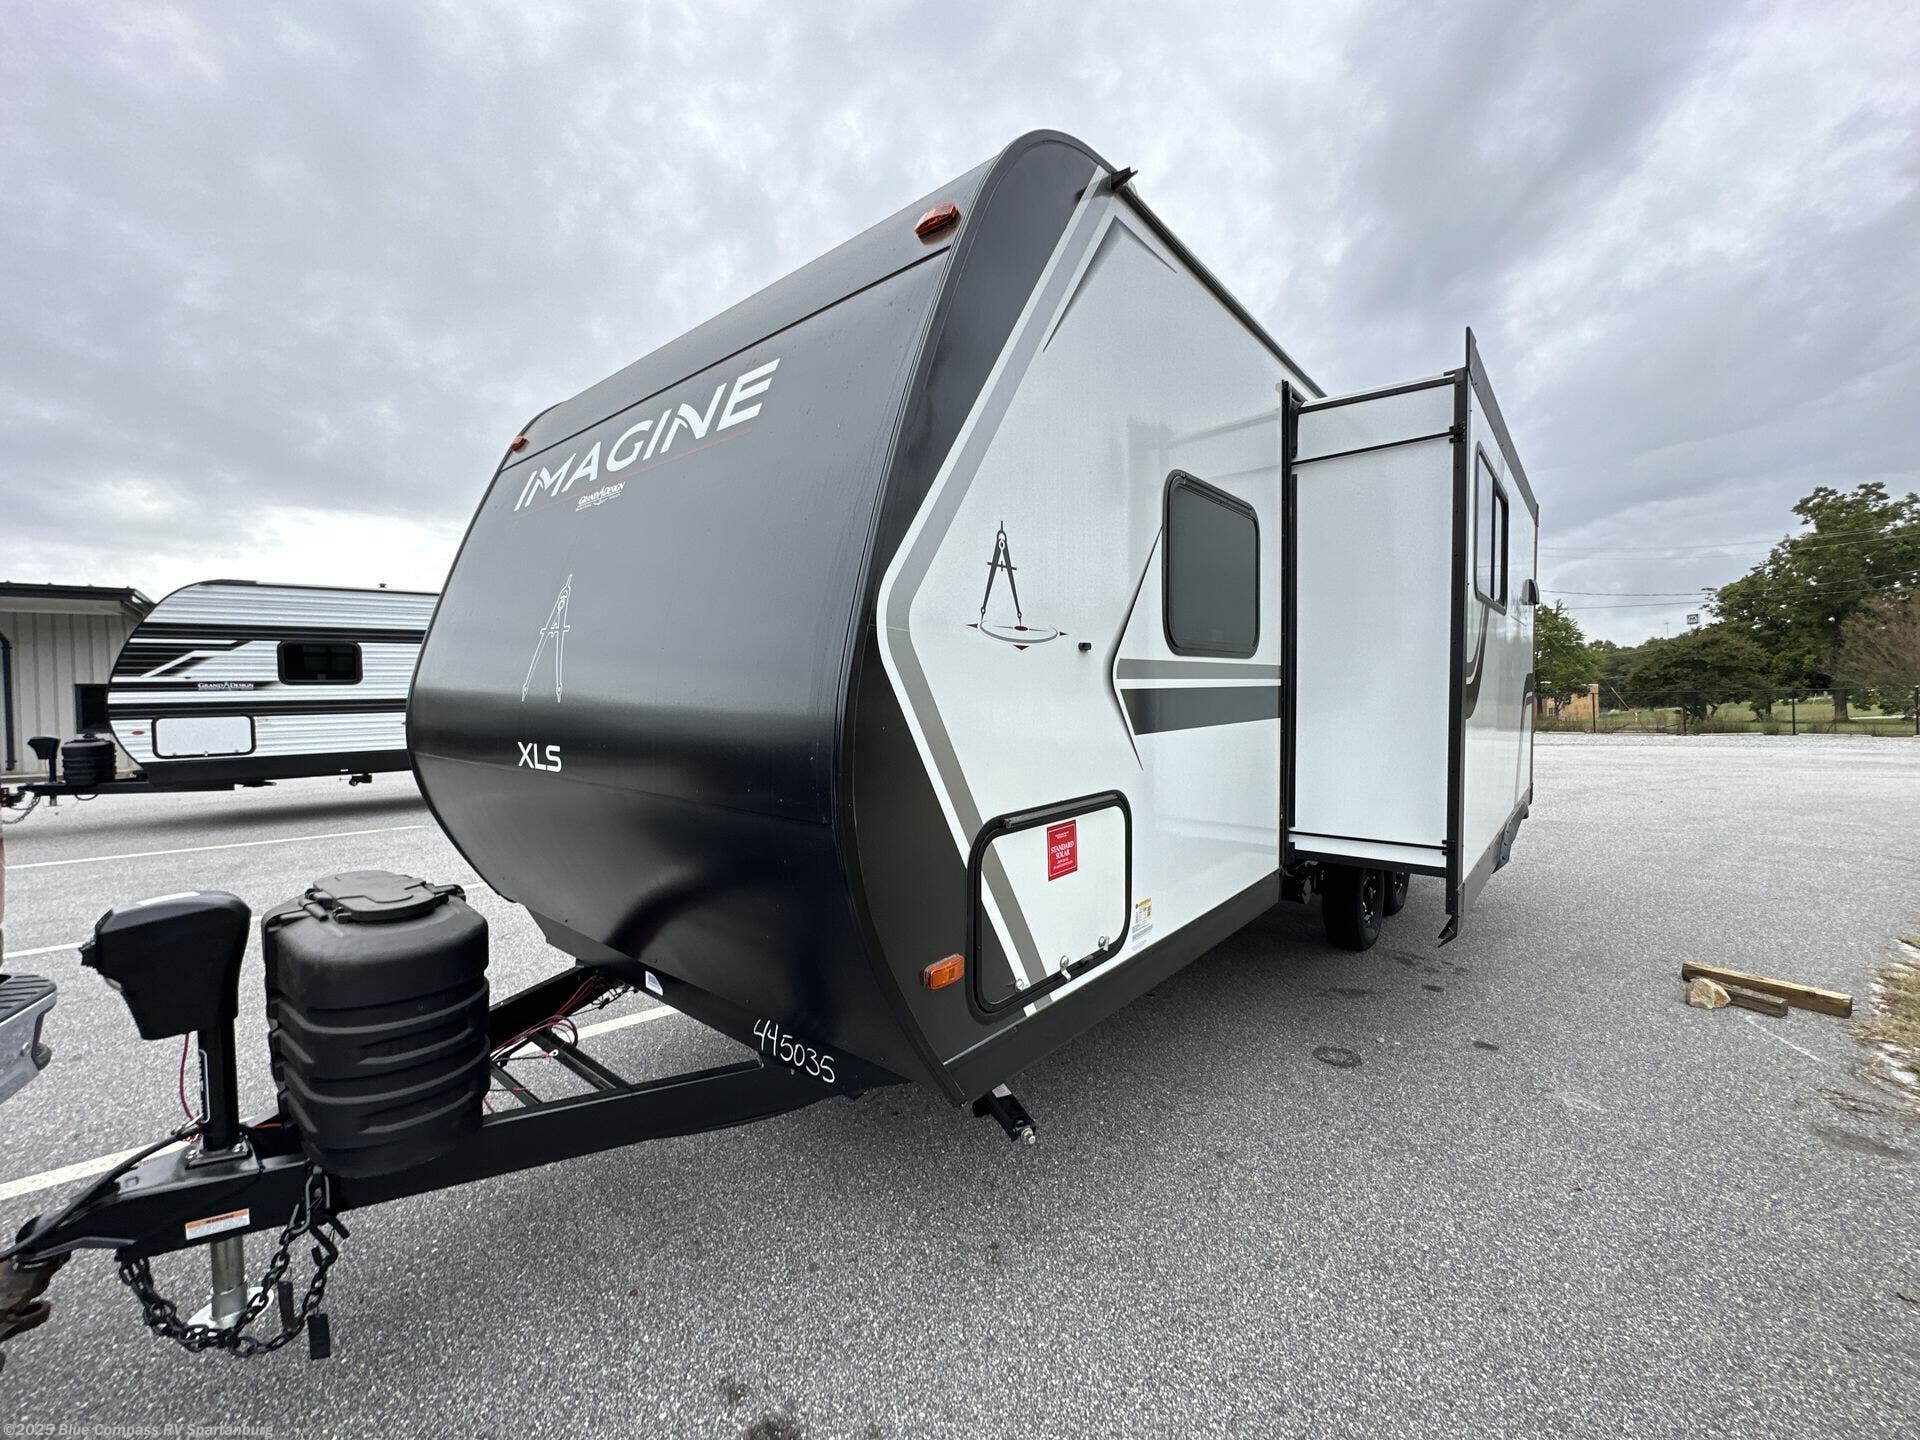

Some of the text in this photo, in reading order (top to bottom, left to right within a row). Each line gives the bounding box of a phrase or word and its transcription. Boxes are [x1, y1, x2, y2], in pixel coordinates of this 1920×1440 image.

[514, 358, 780, 511] IMAGINE
[517, 741, 562, 773] XLS
[1050, 840, 1075, 854] STANDARD
[1055, 849, 1071, 860] SOLAR
[753, 1018, 835, 1083] 445035
